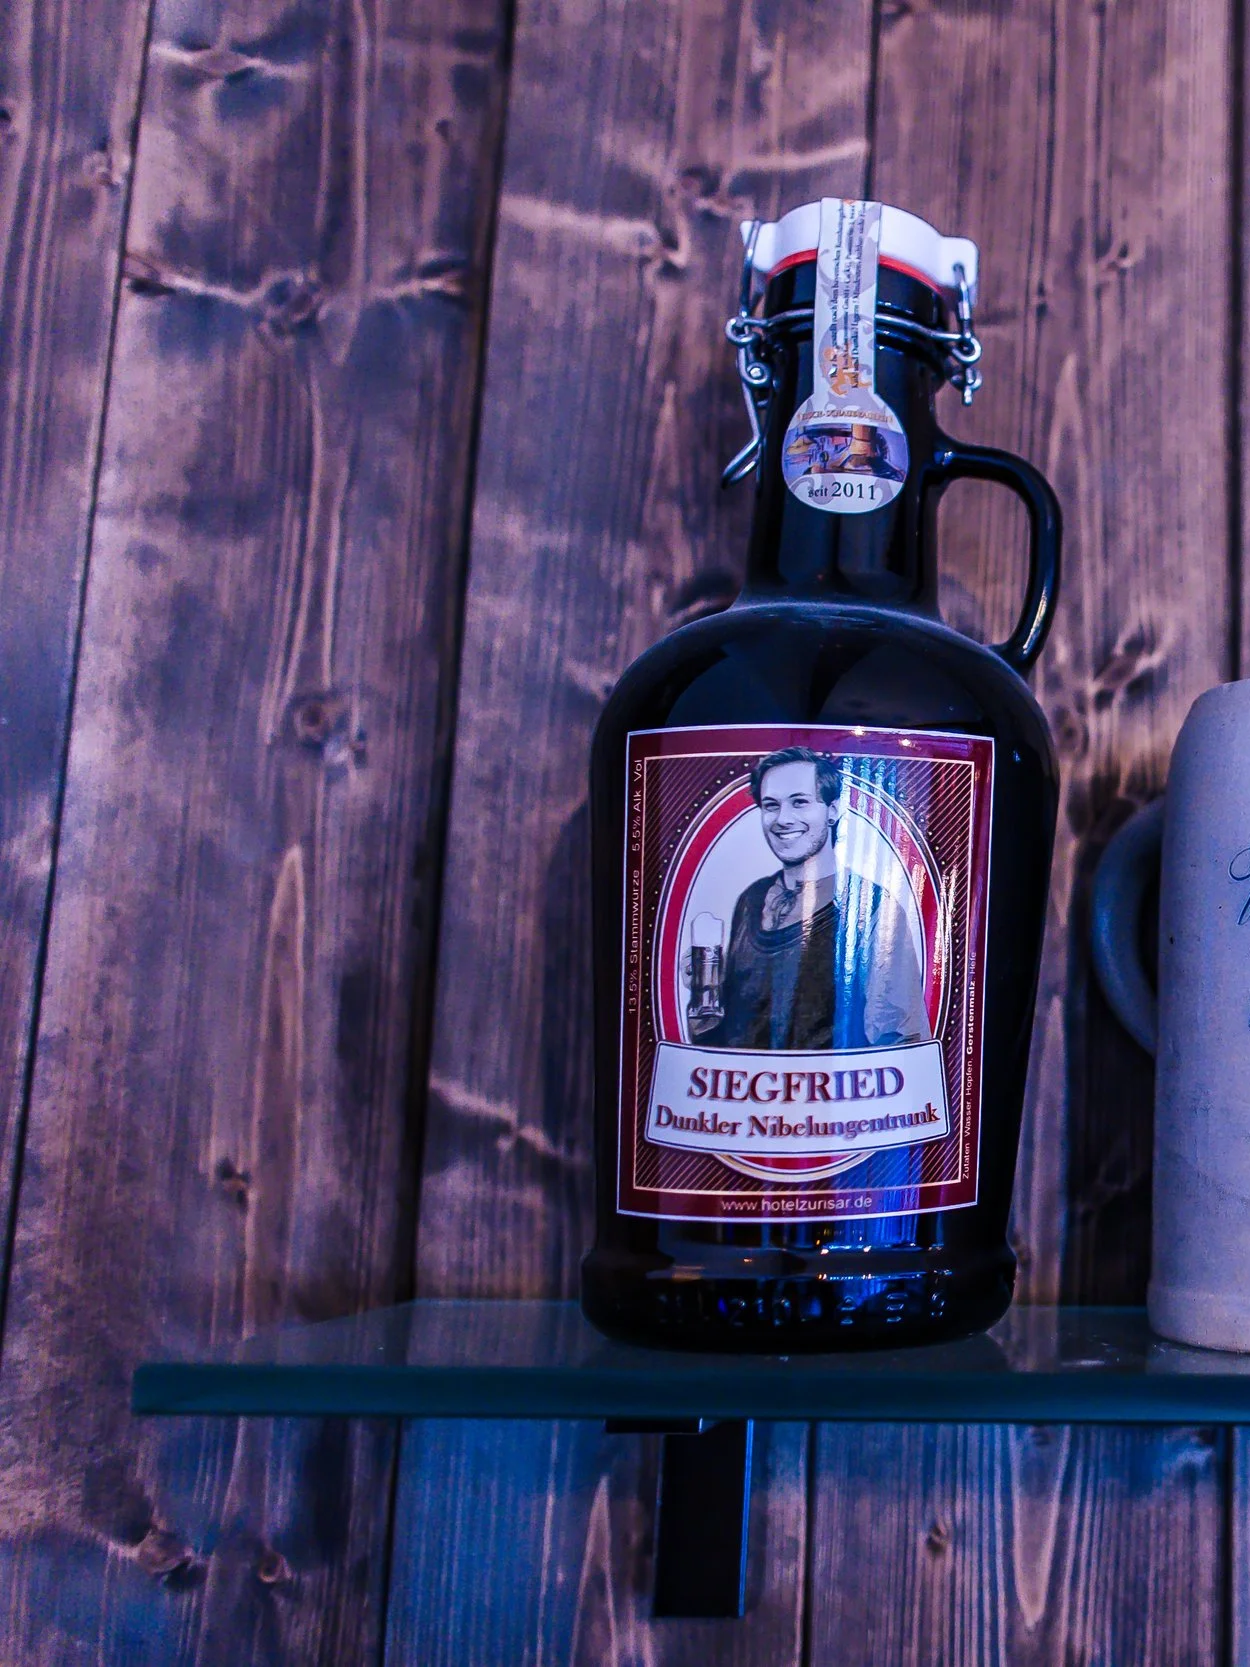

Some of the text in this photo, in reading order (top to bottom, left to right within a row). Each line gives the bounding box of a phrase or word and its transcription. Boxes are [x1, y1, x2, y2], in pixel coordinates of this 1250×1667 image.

[808, 481, 876, 500] seit 2011
[687, 1066, 905, 1103] SIEGFRIED
[655, 1102, 941, 1140] Dunkler Nibelungentrunk
[721, 1195, 873, 1213] www.hotelzurisar.de
